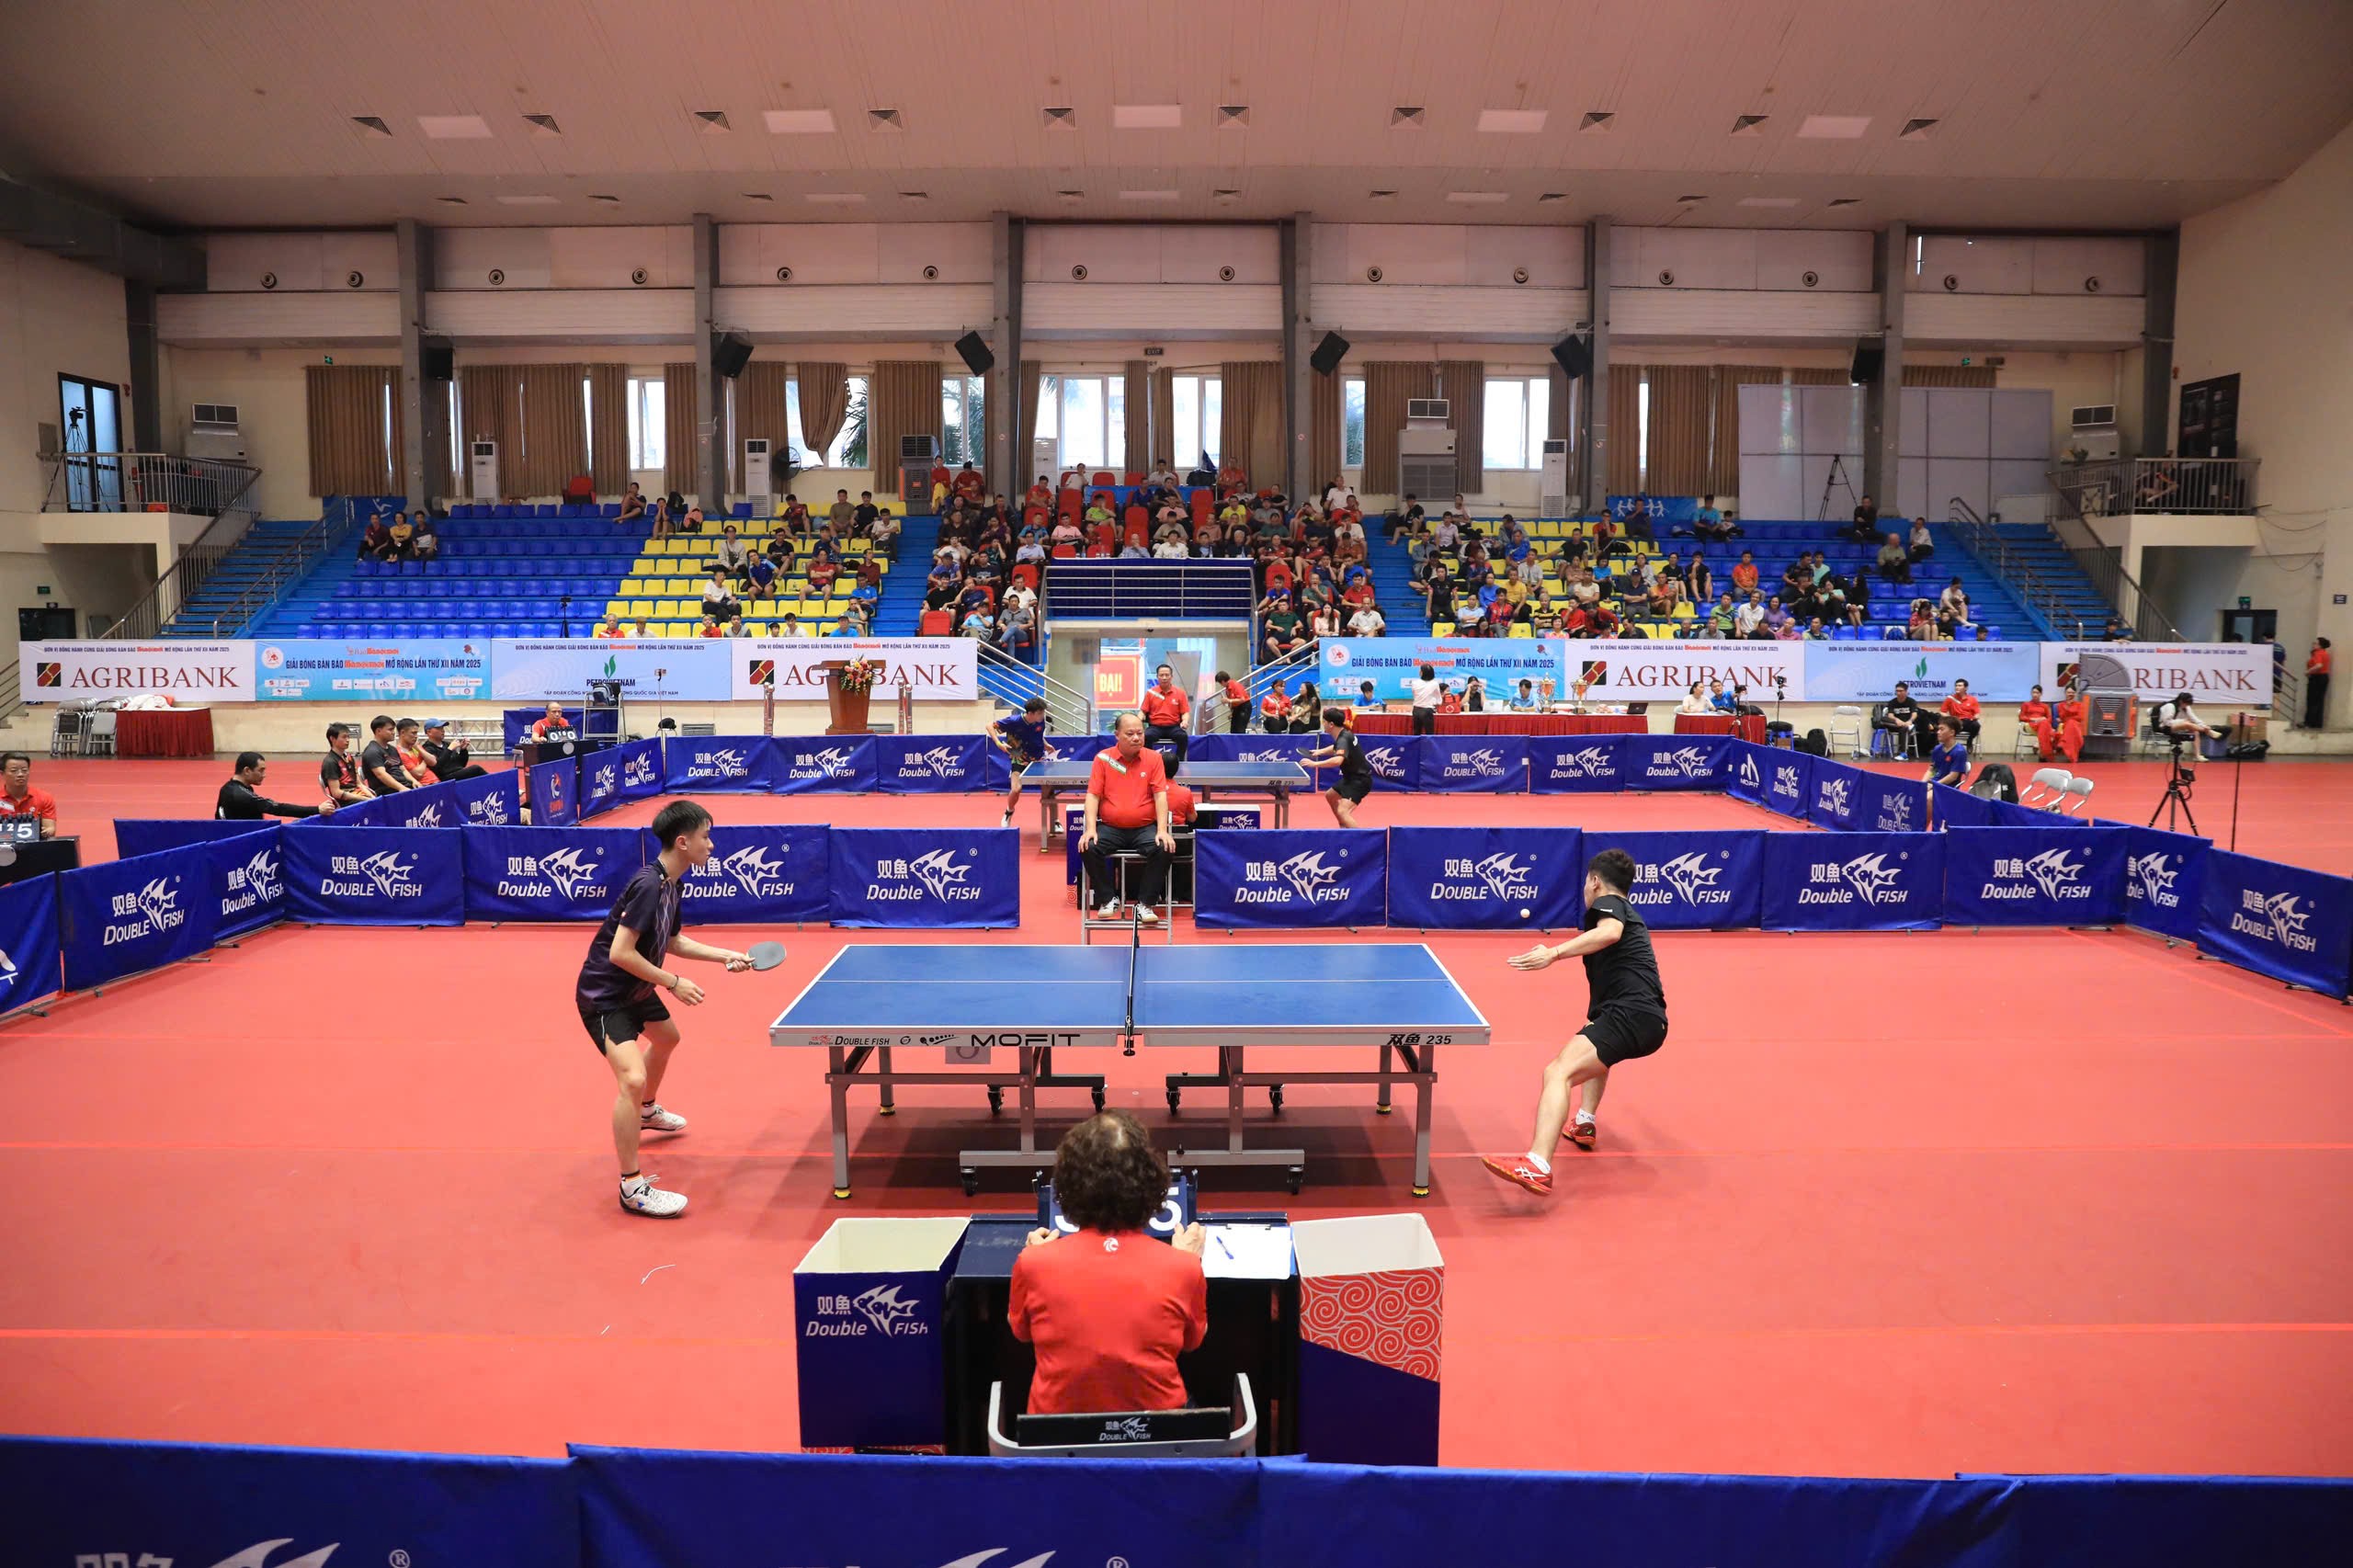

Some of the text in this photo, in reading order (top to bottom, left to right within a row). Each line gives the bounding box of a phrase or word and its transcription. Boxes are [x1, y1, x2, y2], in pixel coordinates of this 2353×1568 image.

[441, 660, 449, 668] XII
[466, 659, 480, 668] 2025
[1513, 659, 1521, 668] XII
[1539, 659, 1554, 668] 2025
[70, 667, 238, 688] AGRIBANK
[784, 665, 961, 685] AGBANK
[1616, 665, 1787, 687] AGRIBANK
[2133, 668, 2257, 690] RIBANK
[550, 732, 558, 740] 0
[645, 773, 655, 782] FISH
[688, 767, 747, 777] DOUBLE FISH
[790, 768, 822, 778] Double
[899, 767, 964, 777] Double FISH
[1444, 767, 1505, 777] DOUBLE FISH
[1551, 767, 1615, 778] Double FISH
[1647, 766, 1712, 778] Double FISH
[17, 823, 32, 838] 5
[321, 880, 422, 896] DOUBLE FISH
[498, 881, 607, 897] Double FISH
[682, 882, 793, 898] Double FISH
[867, 884, 981, 900] Double FISH
[1235, 888, 1349, 903] Double FISH
[1431, 883, 1538, 900] DOUBLE FISH
[1799, 888, 1907, 903] Double FISH
[1982, 883, 2091, 898] Double FISH
[2127, 883, 2178, 907] ble FISH
[222, 892, 256, 915] Double
[1628, 889, 1731, 904] ouble FISH
[104, 910, 184, 945] DOUBLE FISH
[2231, 913, 2316, 951] DOUBLE FISH
[835, 1036, 869, 1045] DOUBLE
[971, 1034, 1080, 1046] MOFIT
[1426, 1035, 1452, 1044] 235
[806, 1319, 927, 1335] Double FISH
